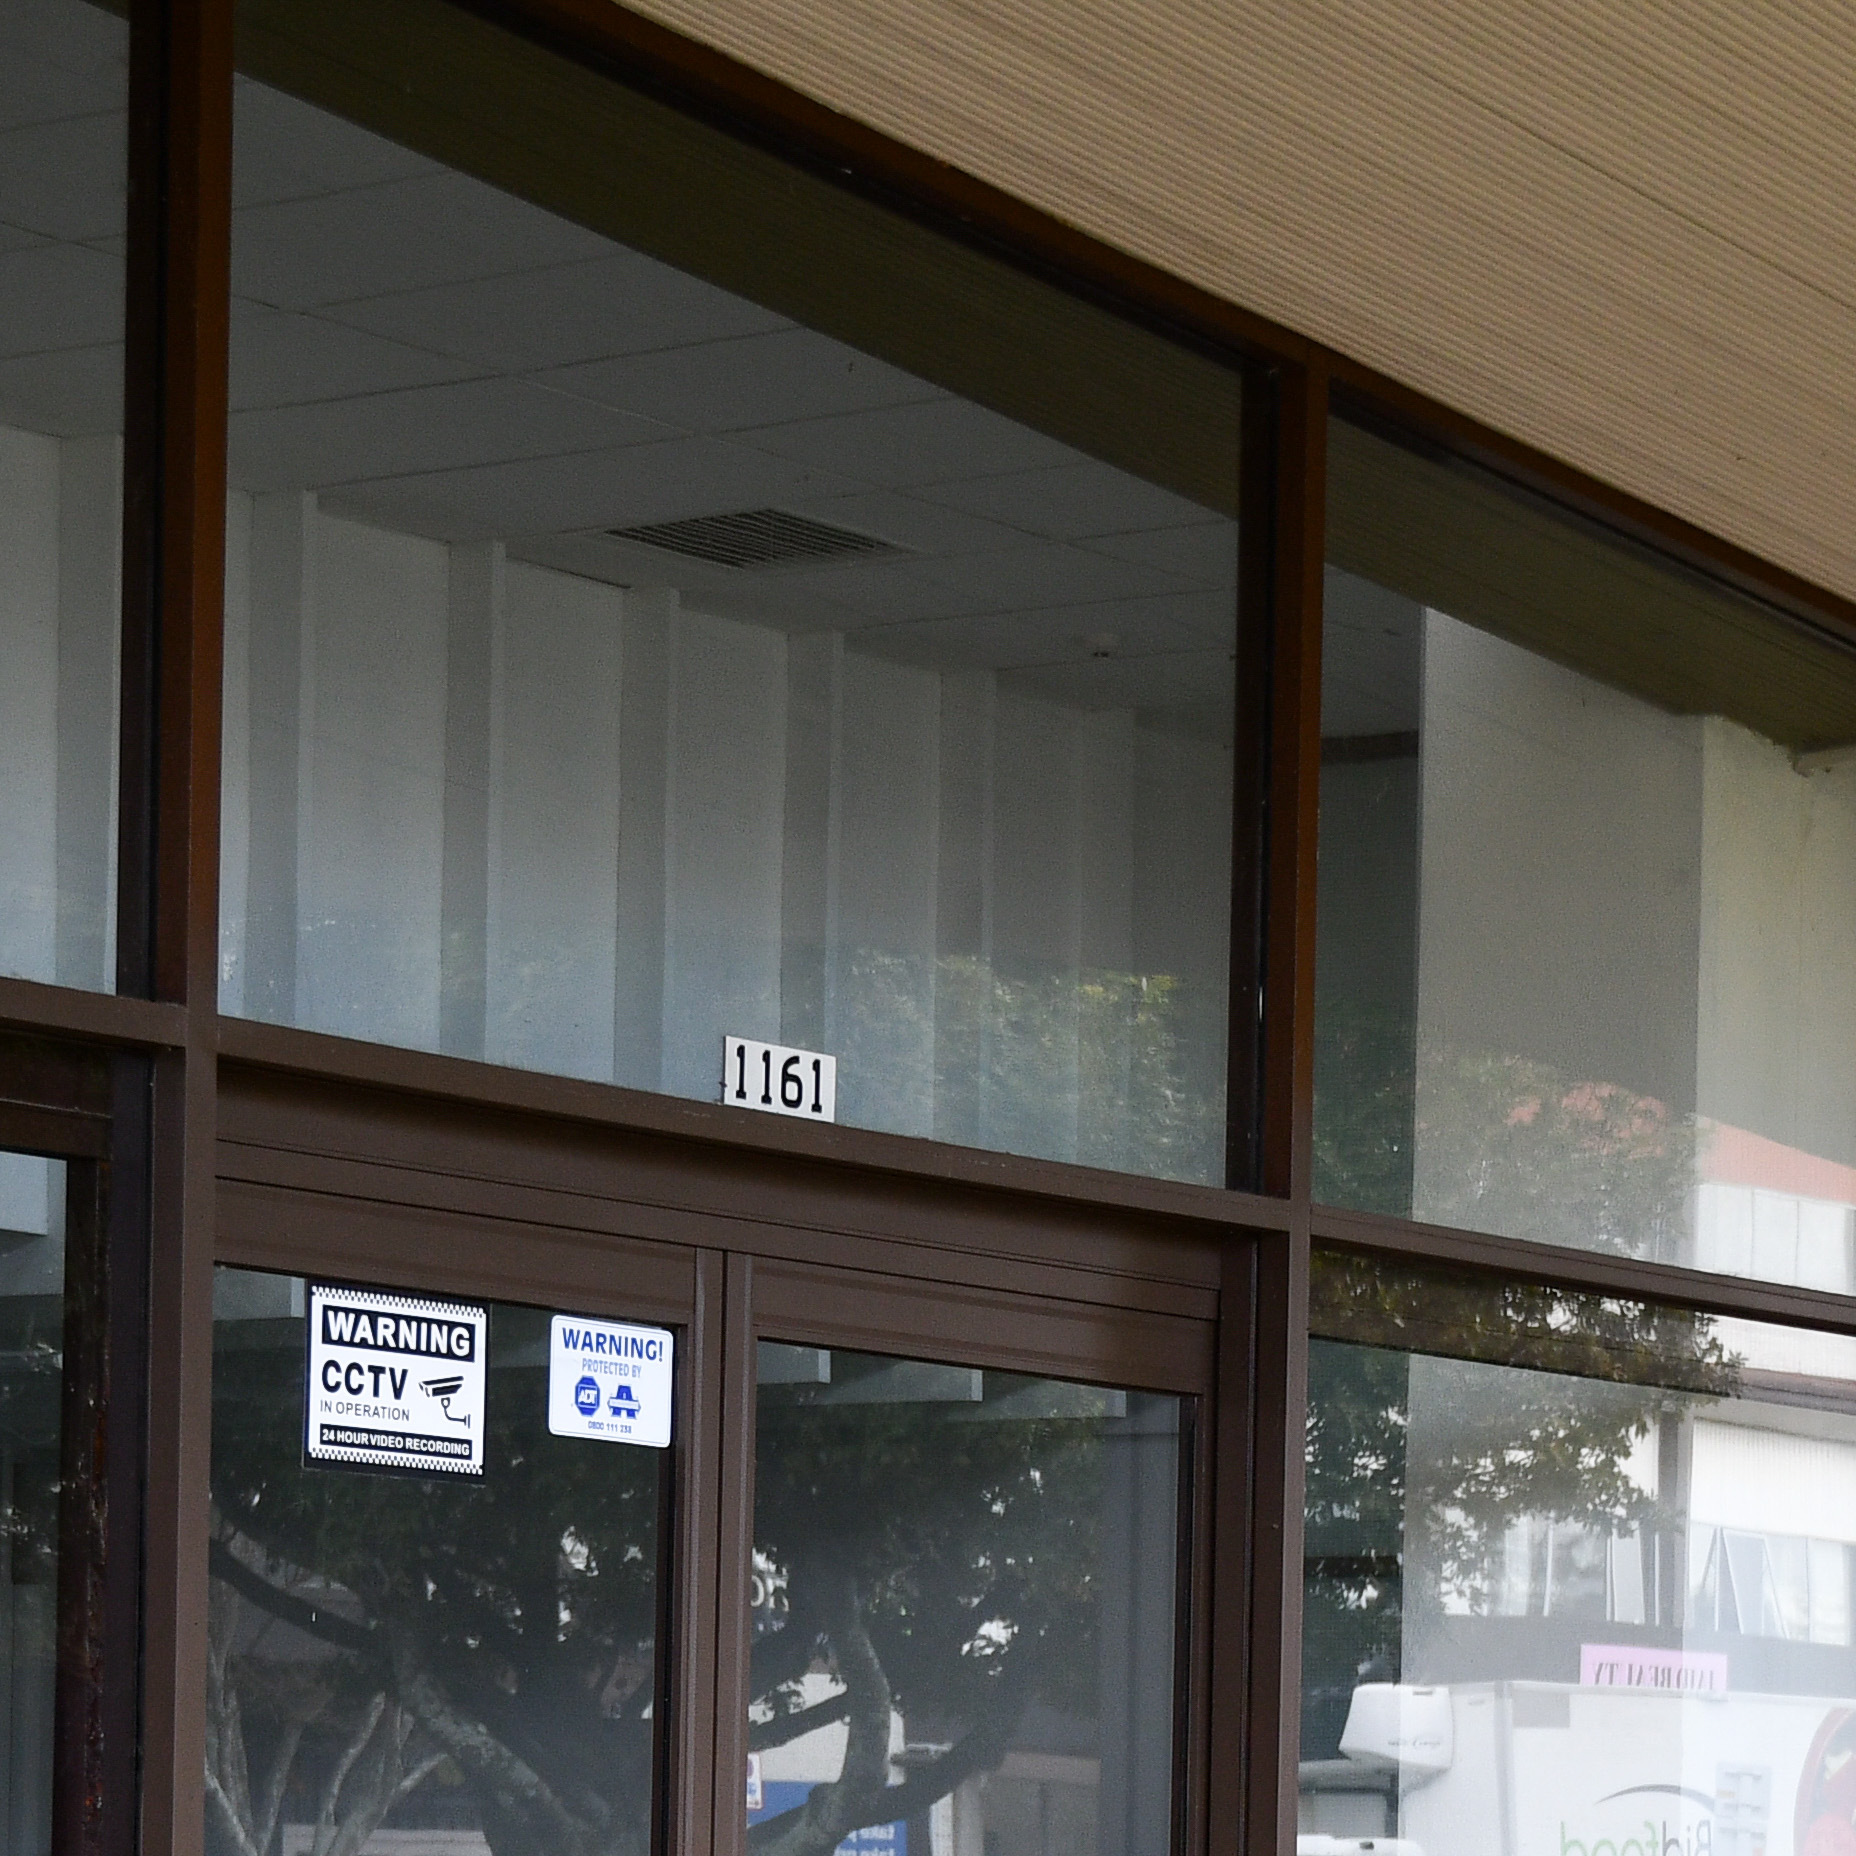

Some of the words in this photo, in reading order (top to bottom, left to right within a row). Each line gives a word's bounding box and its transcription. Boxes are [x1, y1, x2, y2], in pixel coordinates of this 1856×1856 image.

[734, 1045, 824, 1114] 1161
[327, 1310, 470, 1357] WARNING
[562, 1327, 663, 1362] WARNING!
[321, 1359, 409, 1400] CCTV
[582, 1358, 629, 1377] PROTECTED
[632, 1364, 642, 1378] BY
[320, 1399, 332, 1414] IN
[335, 1401, 410, 1421] OPERATION
[577, 1387, 598, 1406] ADT
[588, 1420, 605, 1430] 0800
[606, 1422, 618, 1432] 111
[322, 1428, 335, 1442] 24
[337, 1431, 368, 1446] HOUR
[369, 1433, 404, 1449] VIDEO
[405, 1437, 470, 1456] RECORDING
